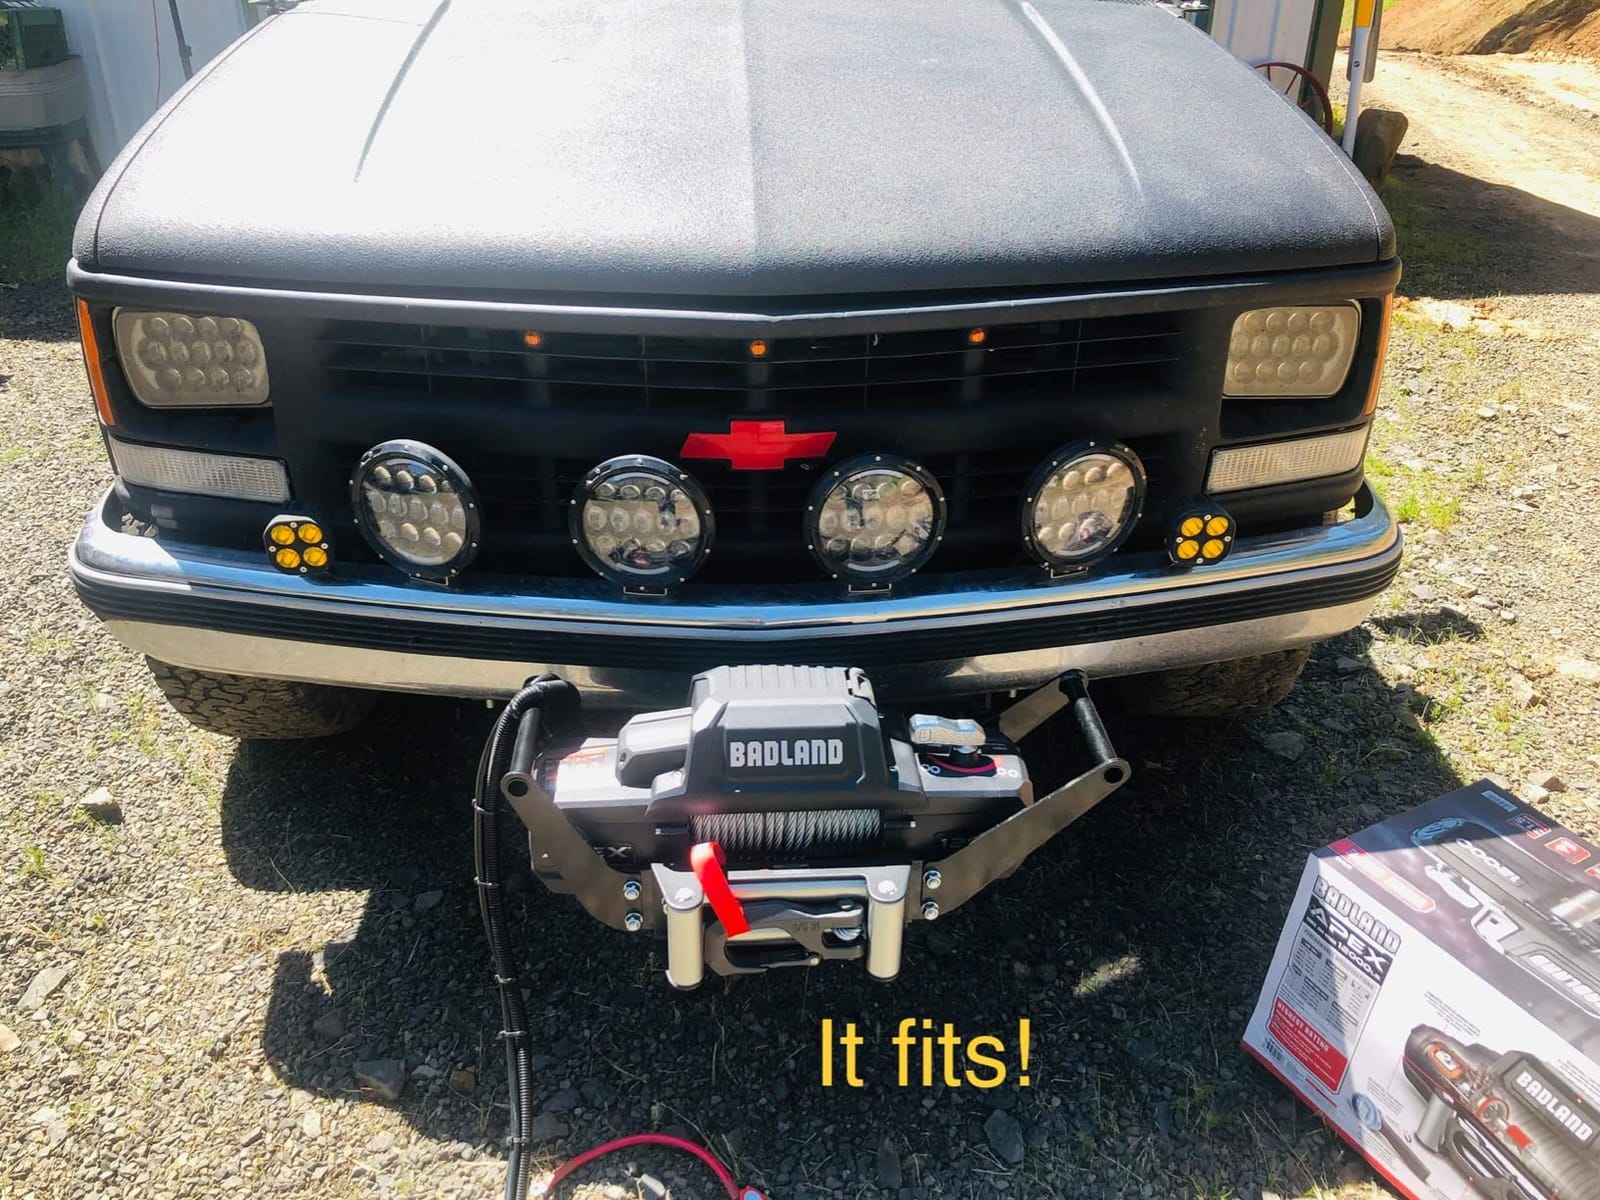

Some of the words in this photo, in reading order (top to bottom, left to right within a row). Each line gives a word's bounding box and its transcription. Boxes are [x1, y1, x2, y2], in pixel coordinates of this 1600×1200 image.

[729, 738, 844, 768] BADLAND
[1311, 907, 1389, 973] APEX
[1312, 875, 1402, 955] BADLAND
[1304, 1026, 1330, 1052] RATING
[1515, 1071, 1593, 1142] BADLAND
